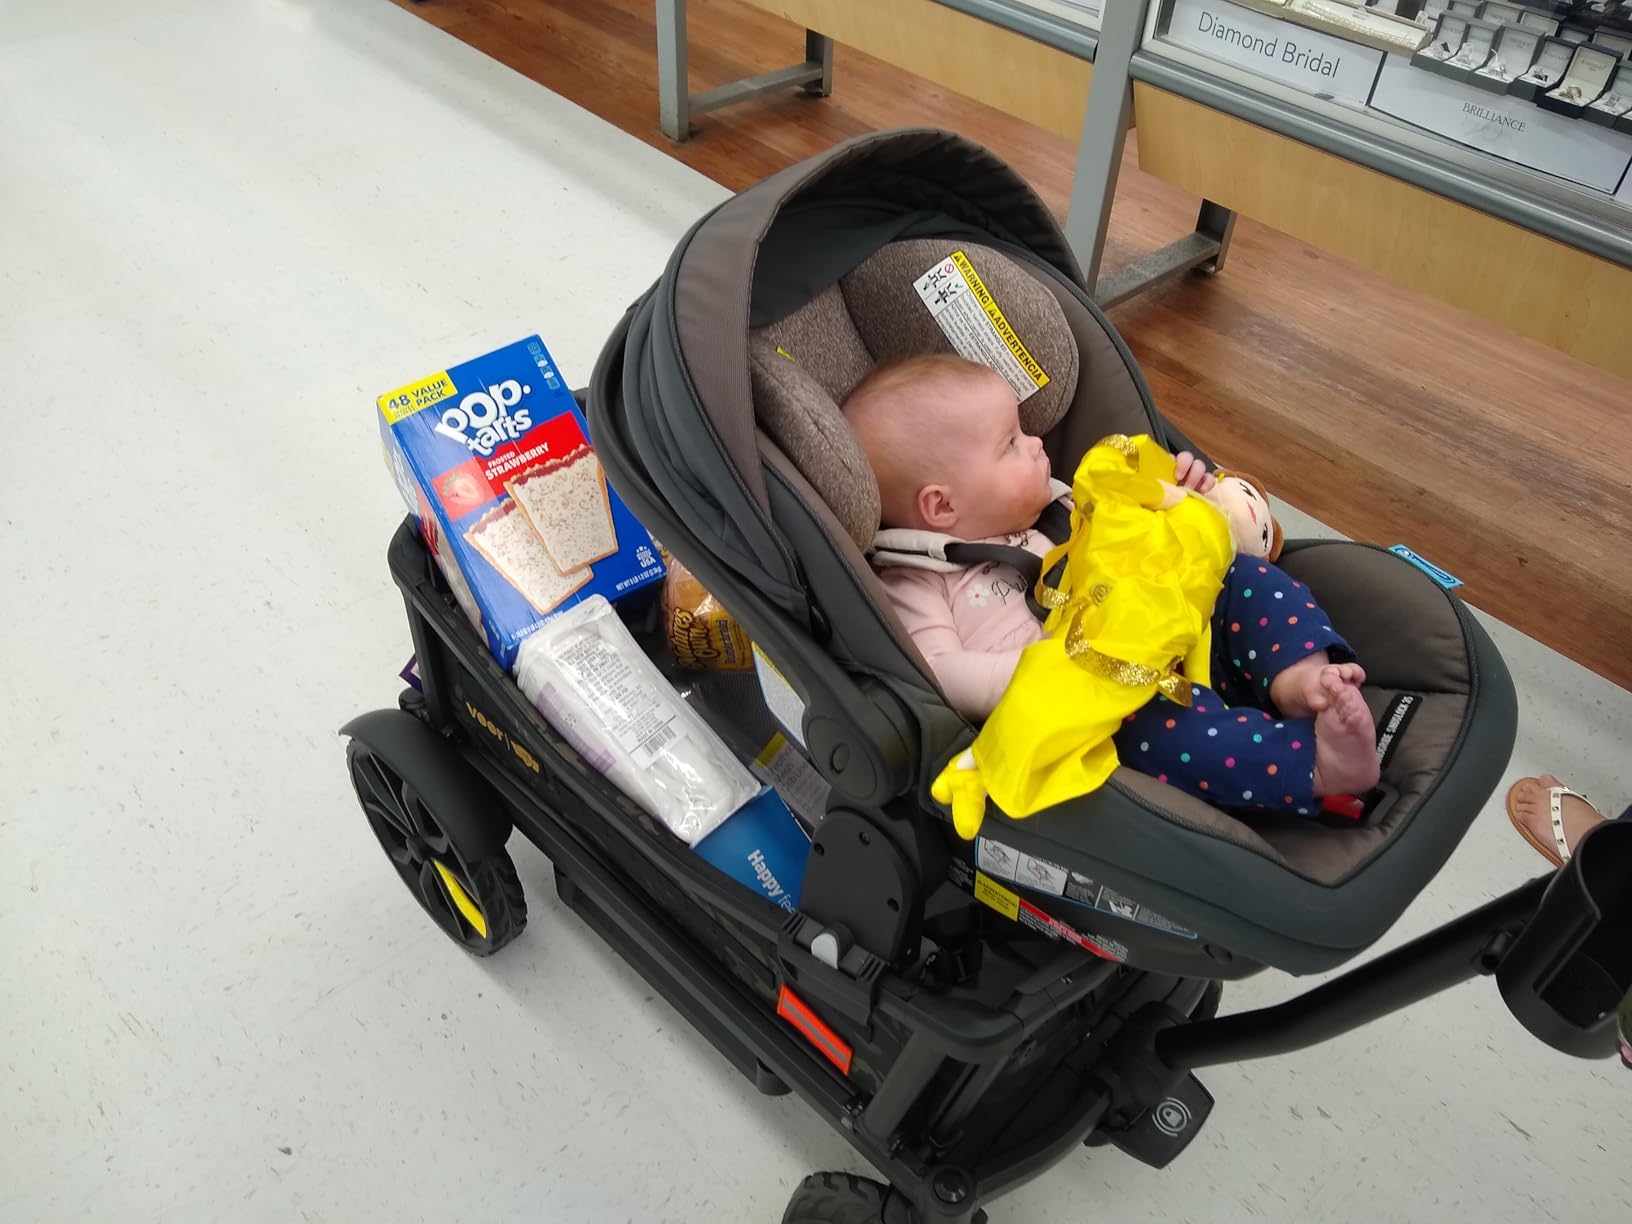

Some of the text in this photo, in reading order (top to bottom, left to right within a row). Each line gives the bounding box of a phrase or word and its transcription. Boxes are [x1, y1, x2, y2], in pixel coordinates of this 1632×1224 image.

[1198, 11, 1341, 78] Diamond Bridal
[1462, 102, 1527, 133] BRILLIANCE
[959, 260, 990, 306] WARNING
[992, 314, 1043, 382] ADVERTENCIA
[388, 393, 411, 411] 48
[412, 379, 449, 399] VALUE
[415, 388, 446, 408] PACK
[484, 441, 550, 481] STRAWBERRY
[487, 450, 516, 469] FROSTED
[639, 556, 656, 569] USA
[747, 849, 784, 898] Happy
